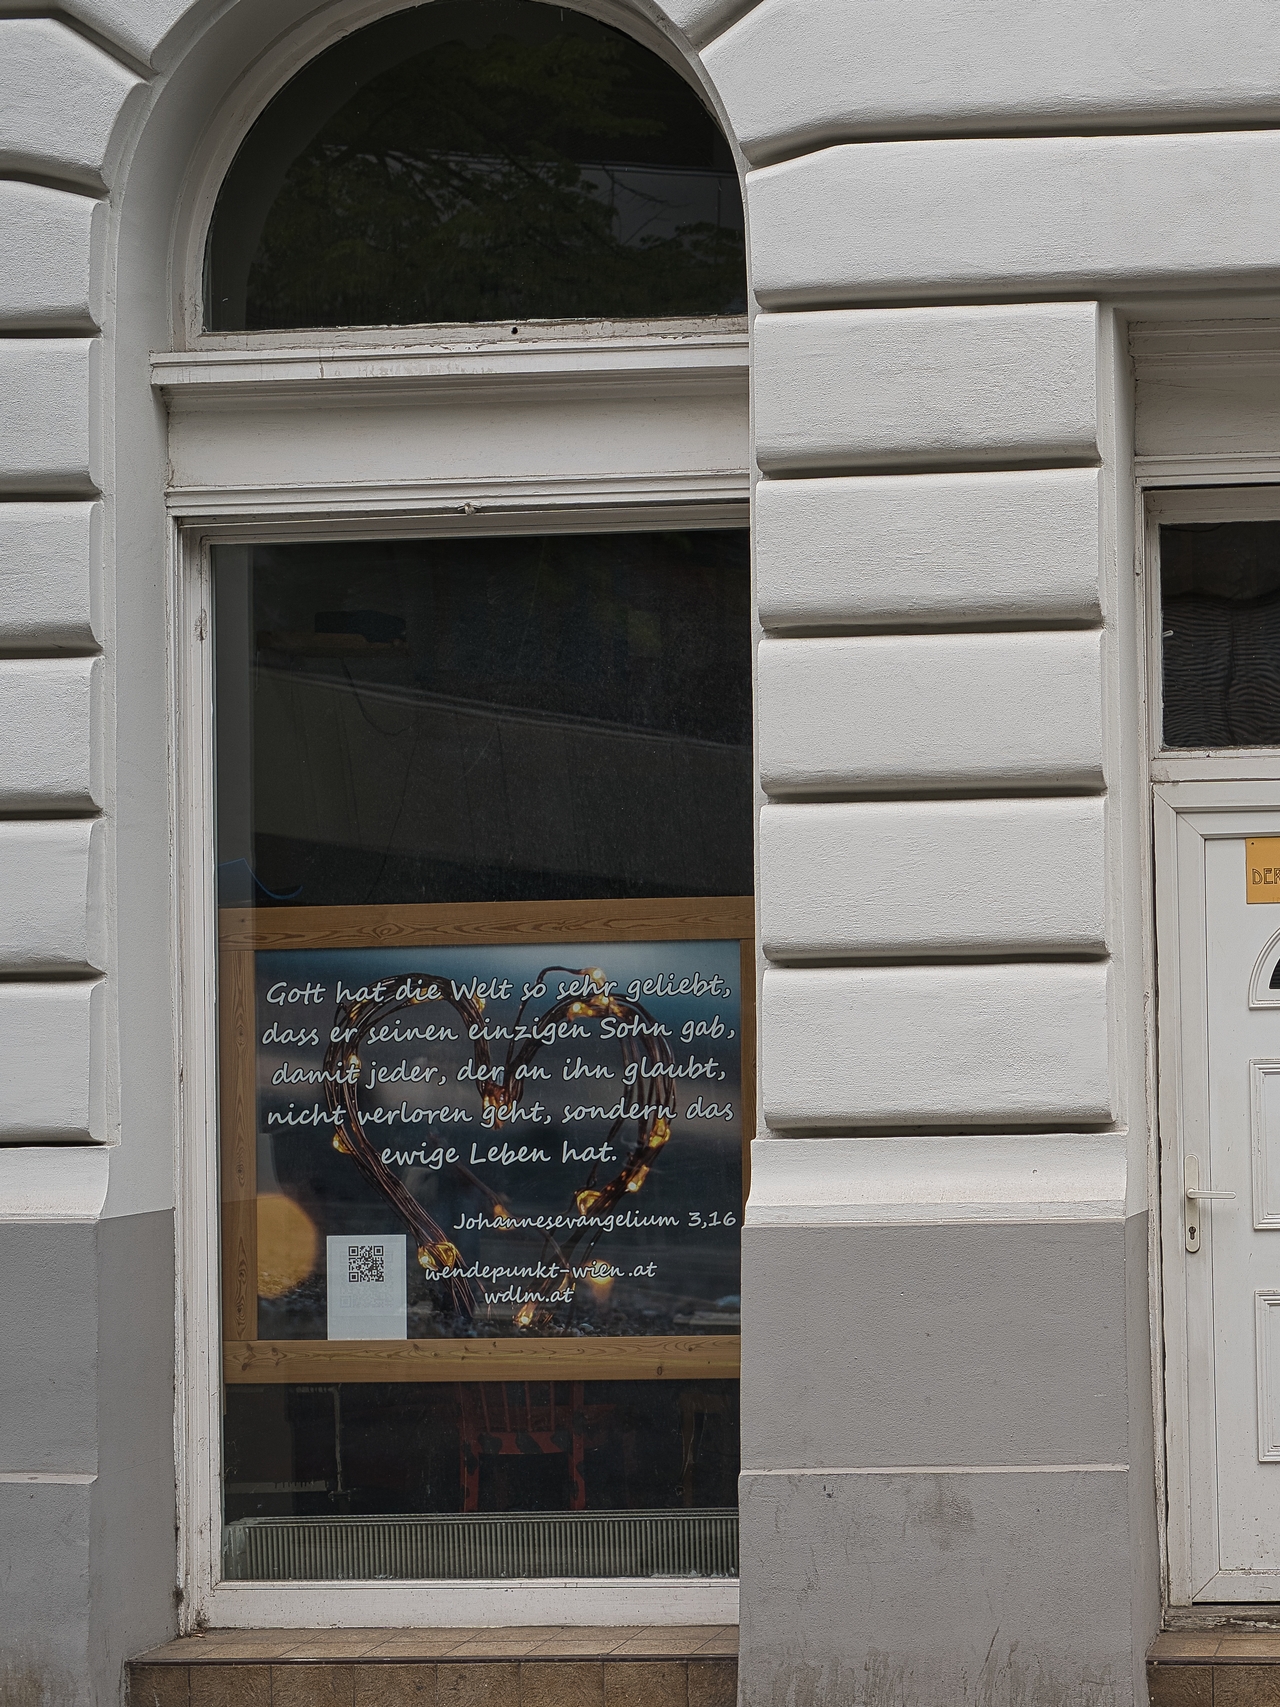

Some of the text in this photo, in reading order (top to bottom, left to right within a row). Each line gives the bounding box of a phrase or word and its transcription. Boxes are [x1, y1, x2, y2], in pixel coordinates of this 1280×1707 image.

[266, 972, 732, 1006] Gott hat die Welt so sehr geliebt,
[261, 1014, 736, 1046] dass er seinen einzigen Sohn gab,
[271, 1054, 727, 1090] damit jeder, der an ihn glaubt,
[267, 1096, 734, 1129] nicht verloren geht, sondern das
[380, 1140, 617, 1171] ewige Leben hat.
[453, 1209, 737, 1232] Johannesevangelium 3,16
[424, 1260, 657, 1284] wendepunkt-wien.at
[484, 1284, 574, 1304] wdlm.at
